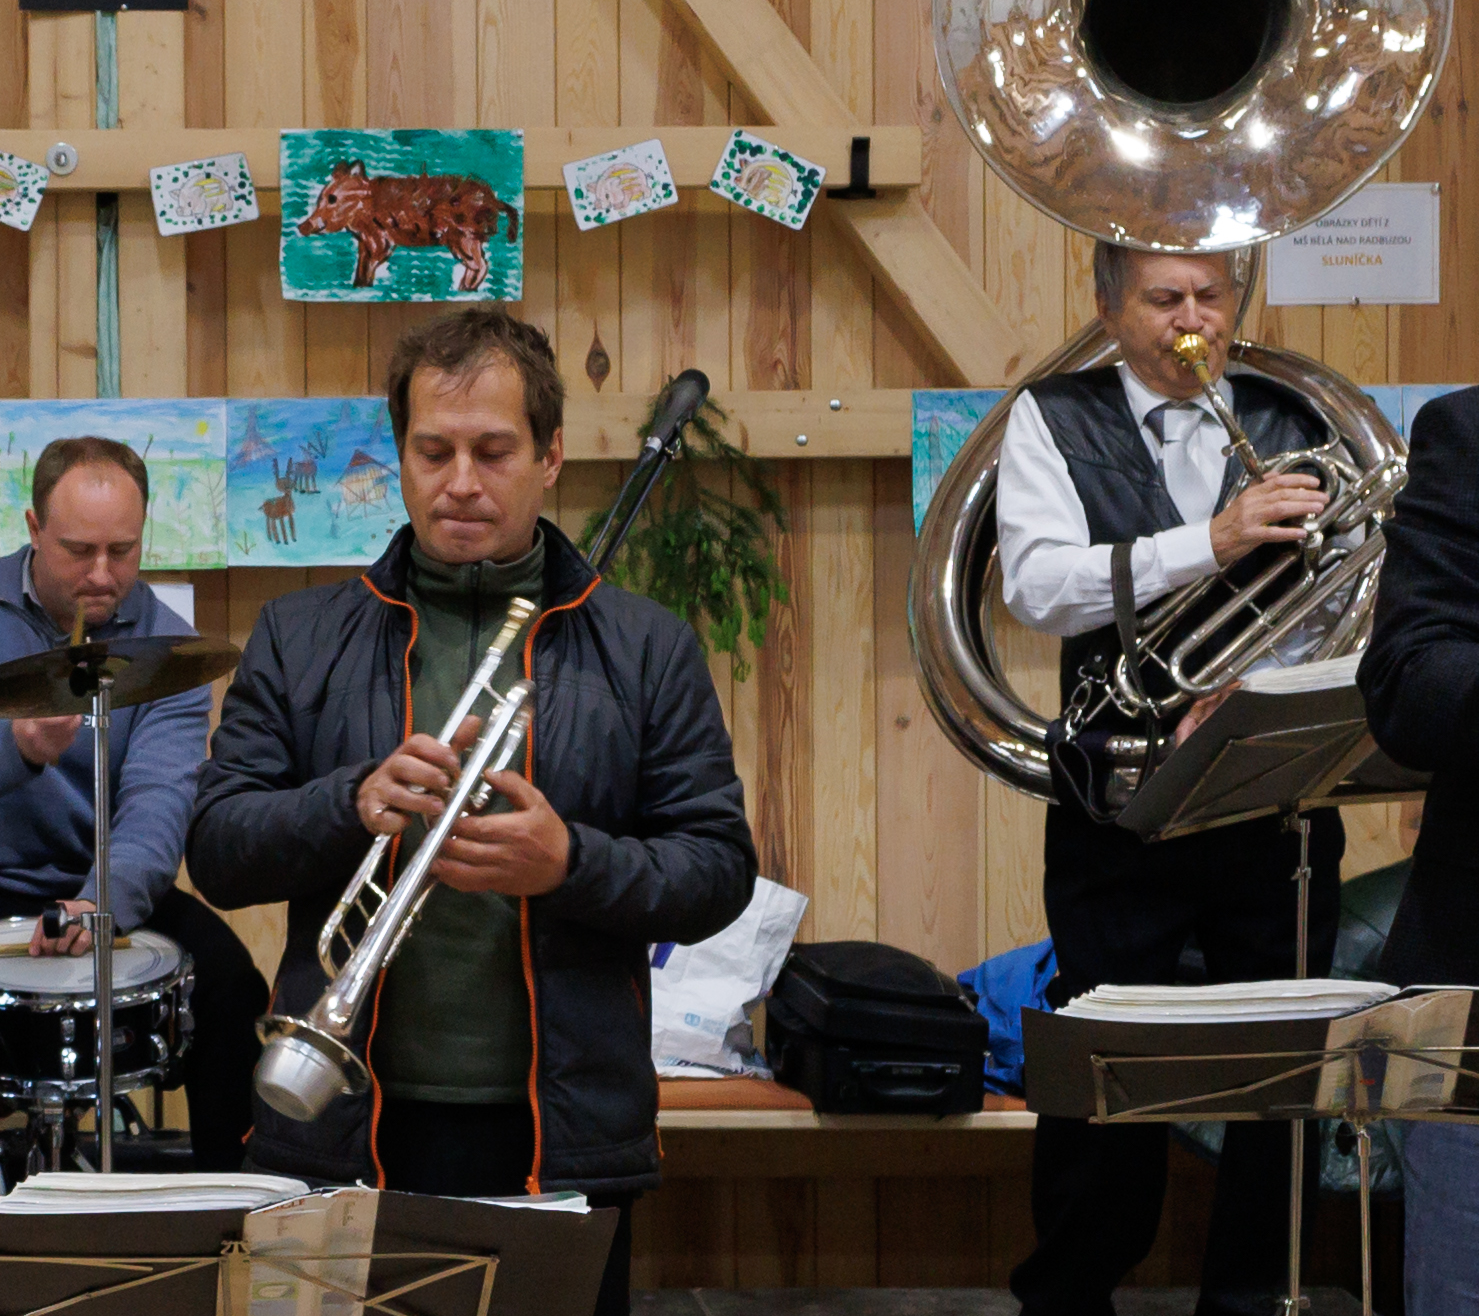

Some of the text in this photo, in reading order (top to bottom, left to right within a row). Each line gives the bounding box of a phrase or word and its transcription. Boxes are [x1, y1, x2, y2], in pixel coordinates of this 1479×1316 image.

[1293, 235, 1308, 245] MŠ
[1336, 236, 1357, 245] NAD
[1322, 253, 1383, 266] SLUNÍČKA
